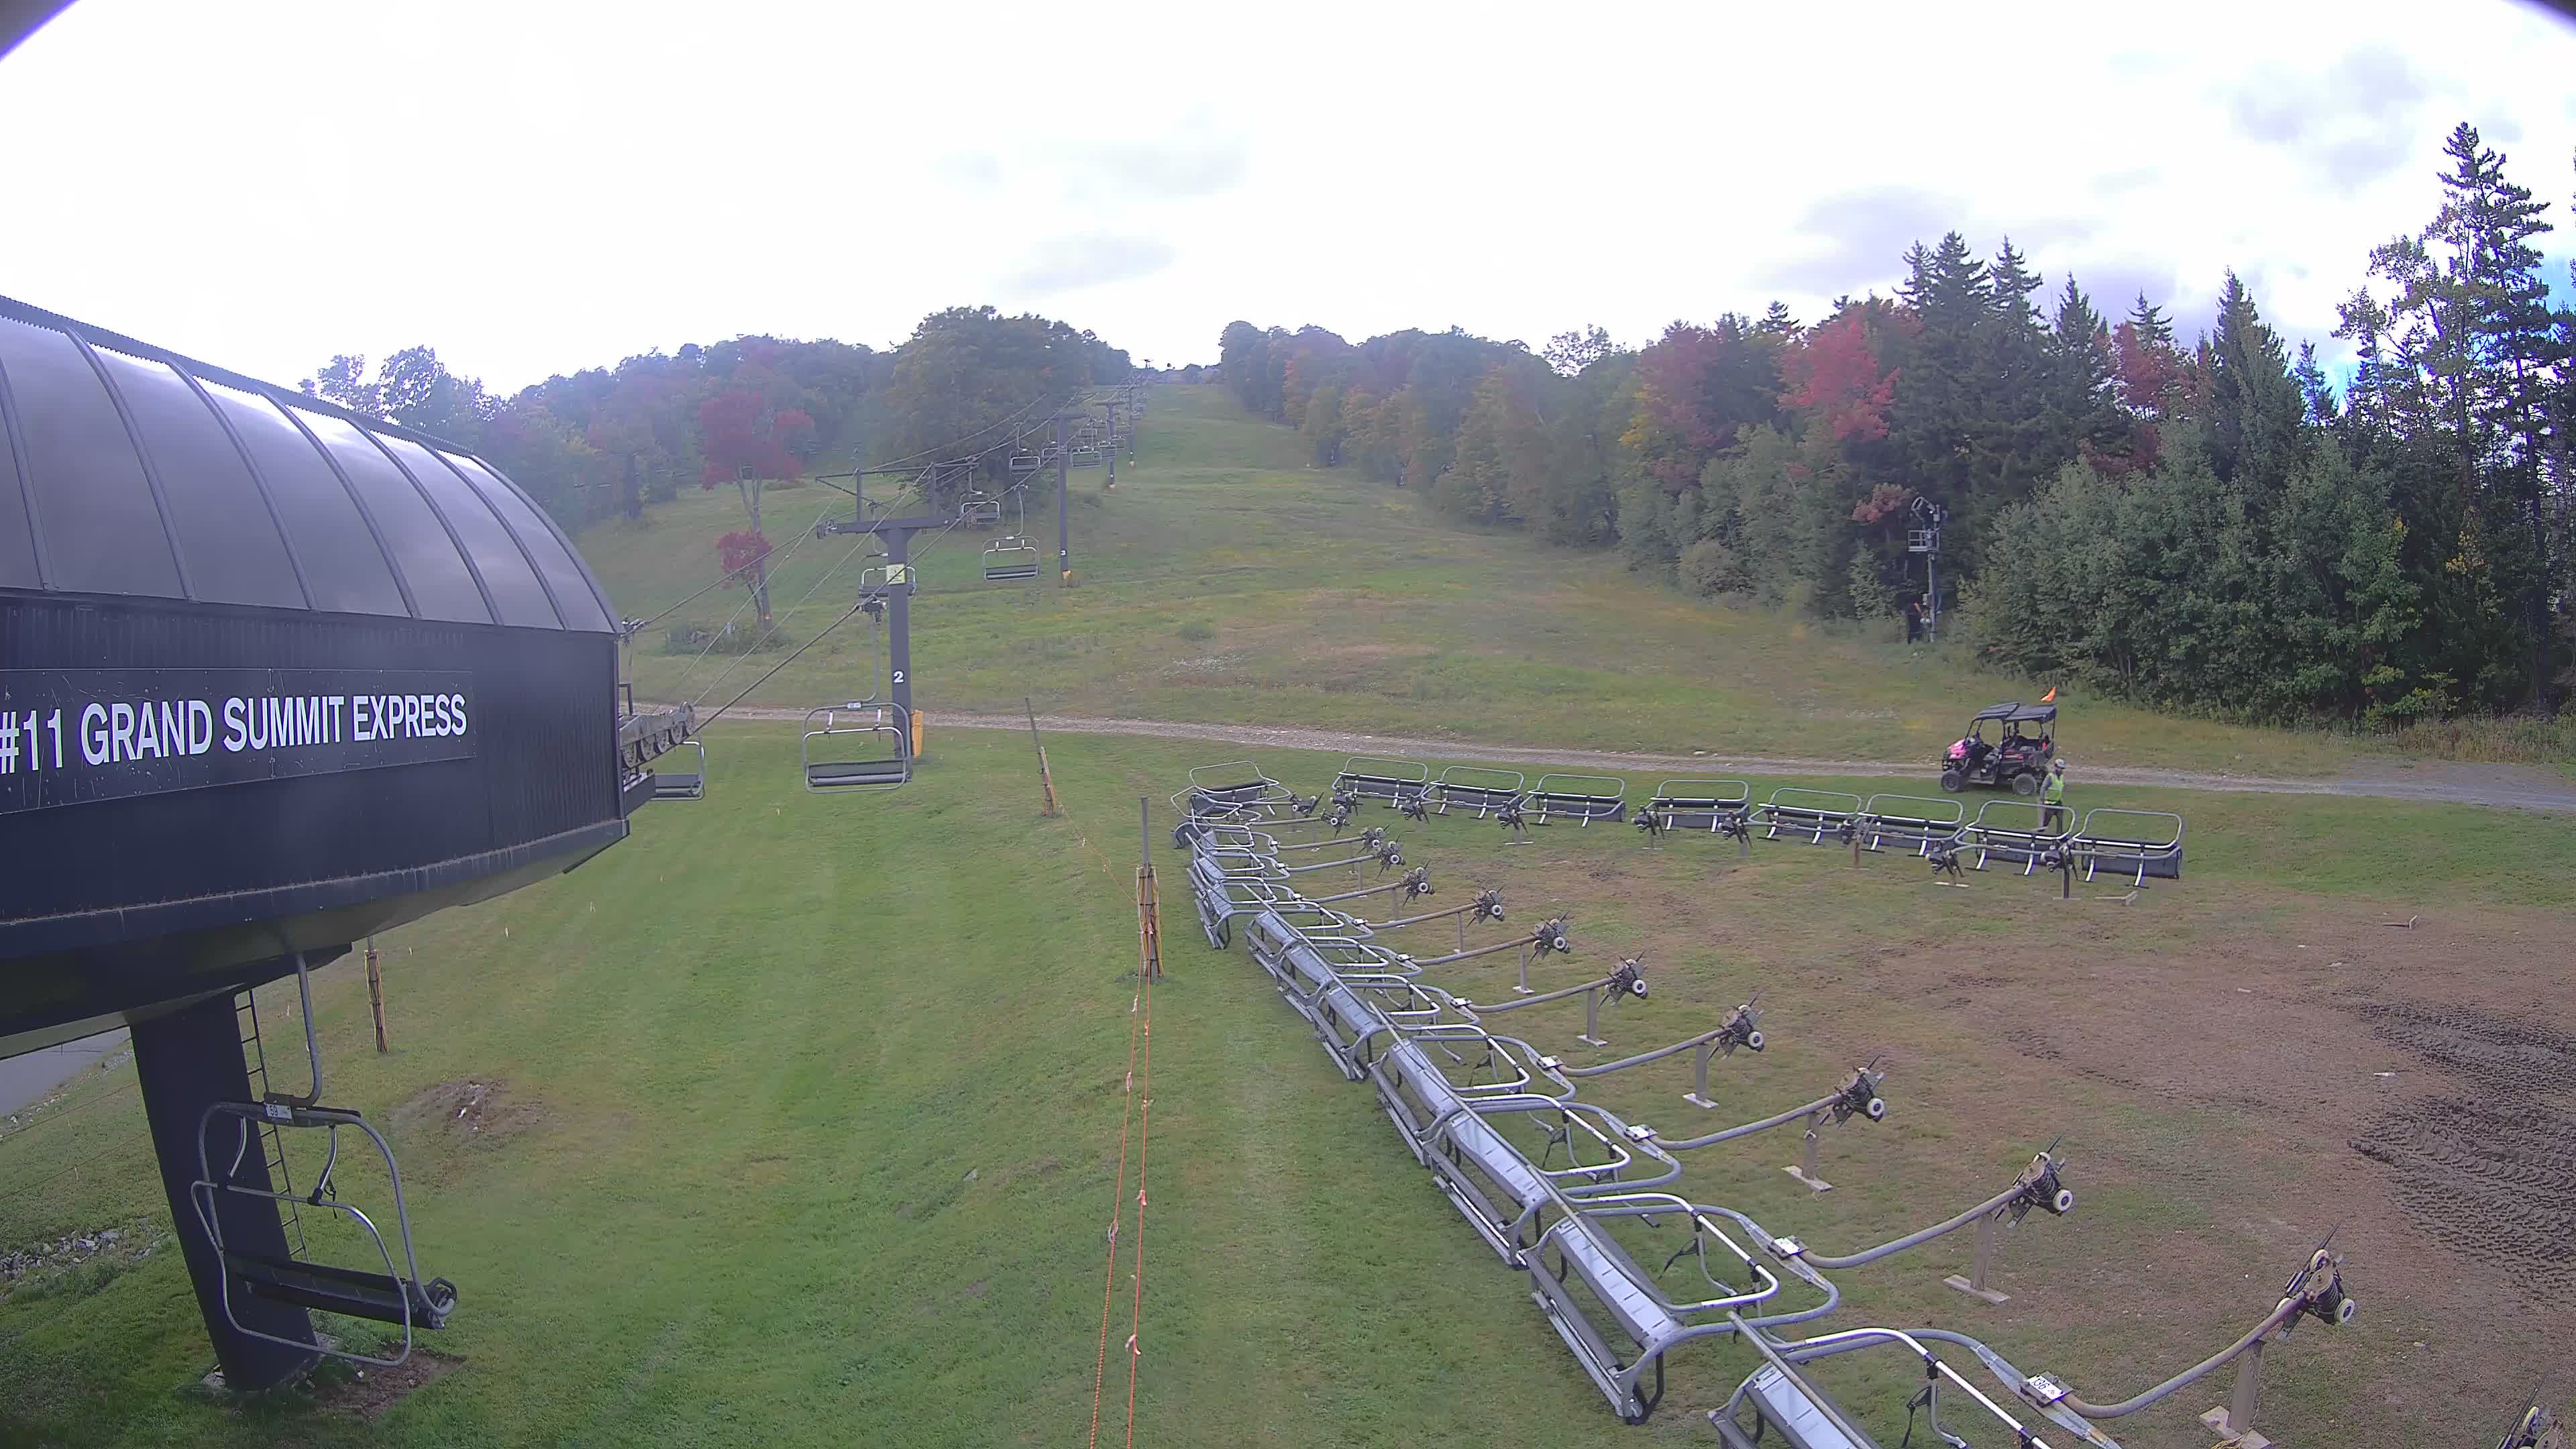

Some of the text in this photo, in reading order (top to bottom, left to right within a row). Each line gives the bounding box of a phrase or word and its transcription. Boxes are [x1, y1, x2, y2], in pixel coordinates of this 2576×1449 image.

[894, 670, 904, 684] 2
[0, 693, 468, 774] #11 GRAND SUMMIT EXPRESS
